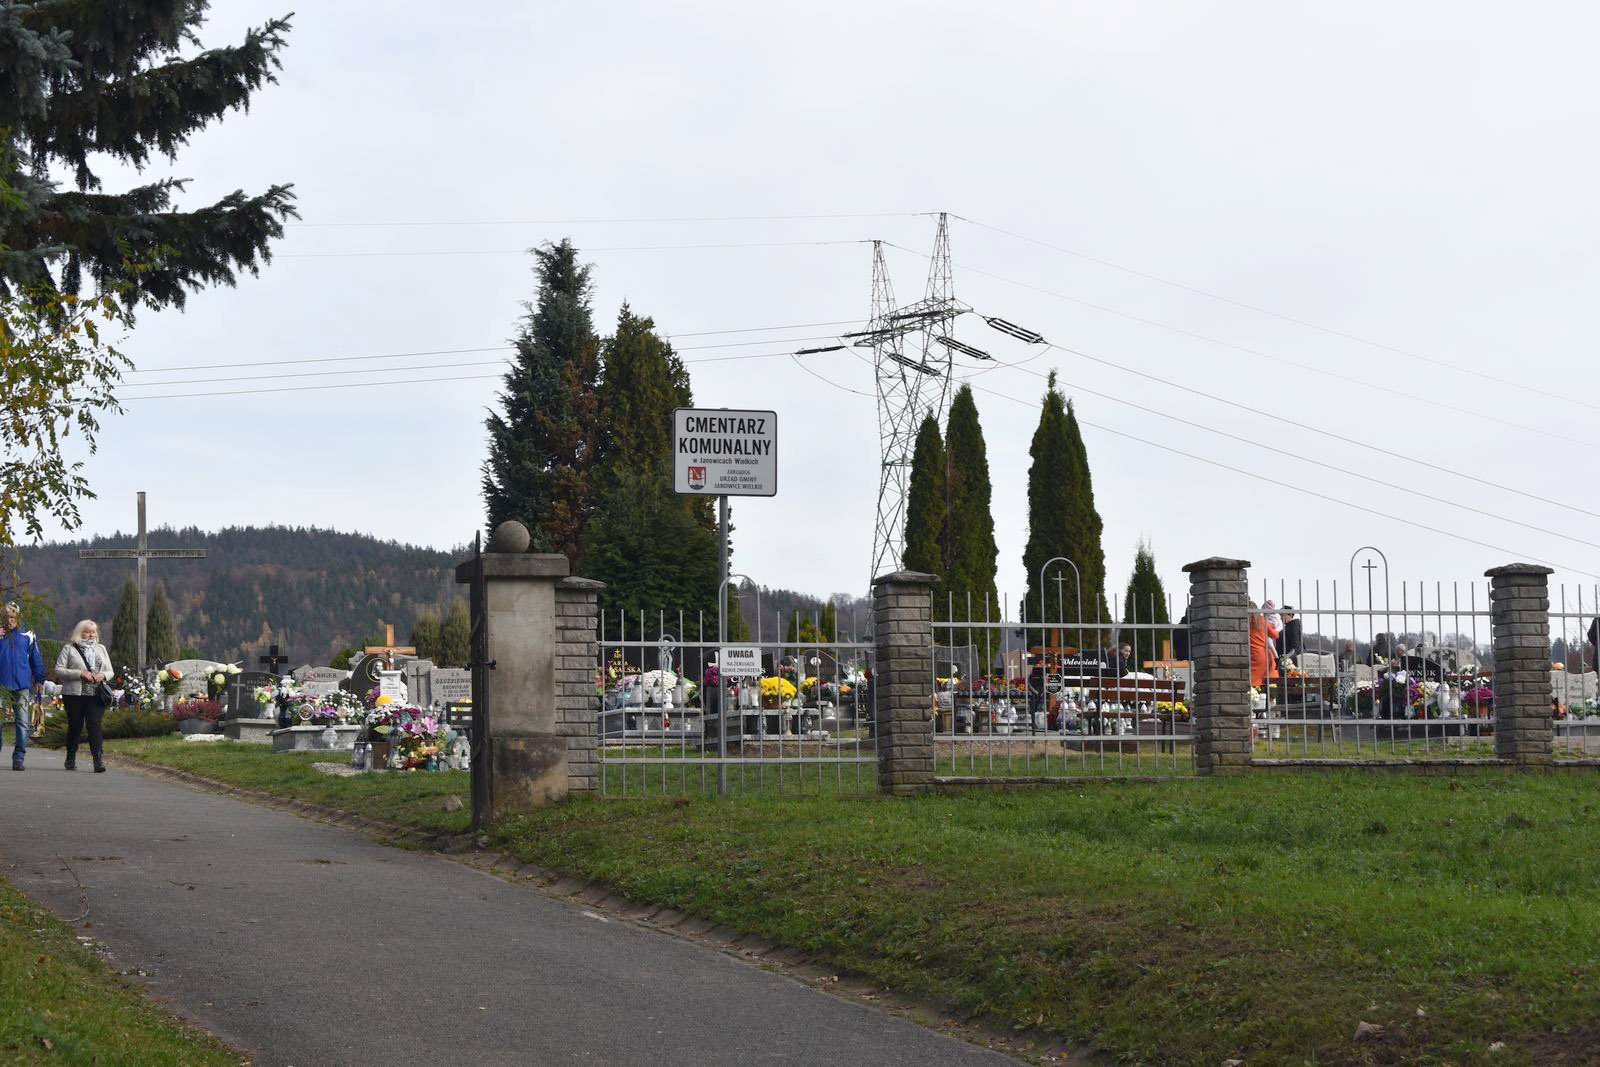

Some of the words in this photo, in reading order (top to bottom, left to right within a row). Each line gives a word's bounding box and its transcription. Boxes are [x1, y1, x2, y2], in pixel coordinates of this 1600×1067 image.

[686, 416, 765, 435] CMENTARZ
[679, 437, 771, 455] KOMUNALNY
[727, 650, 754, 658] UWAGA
